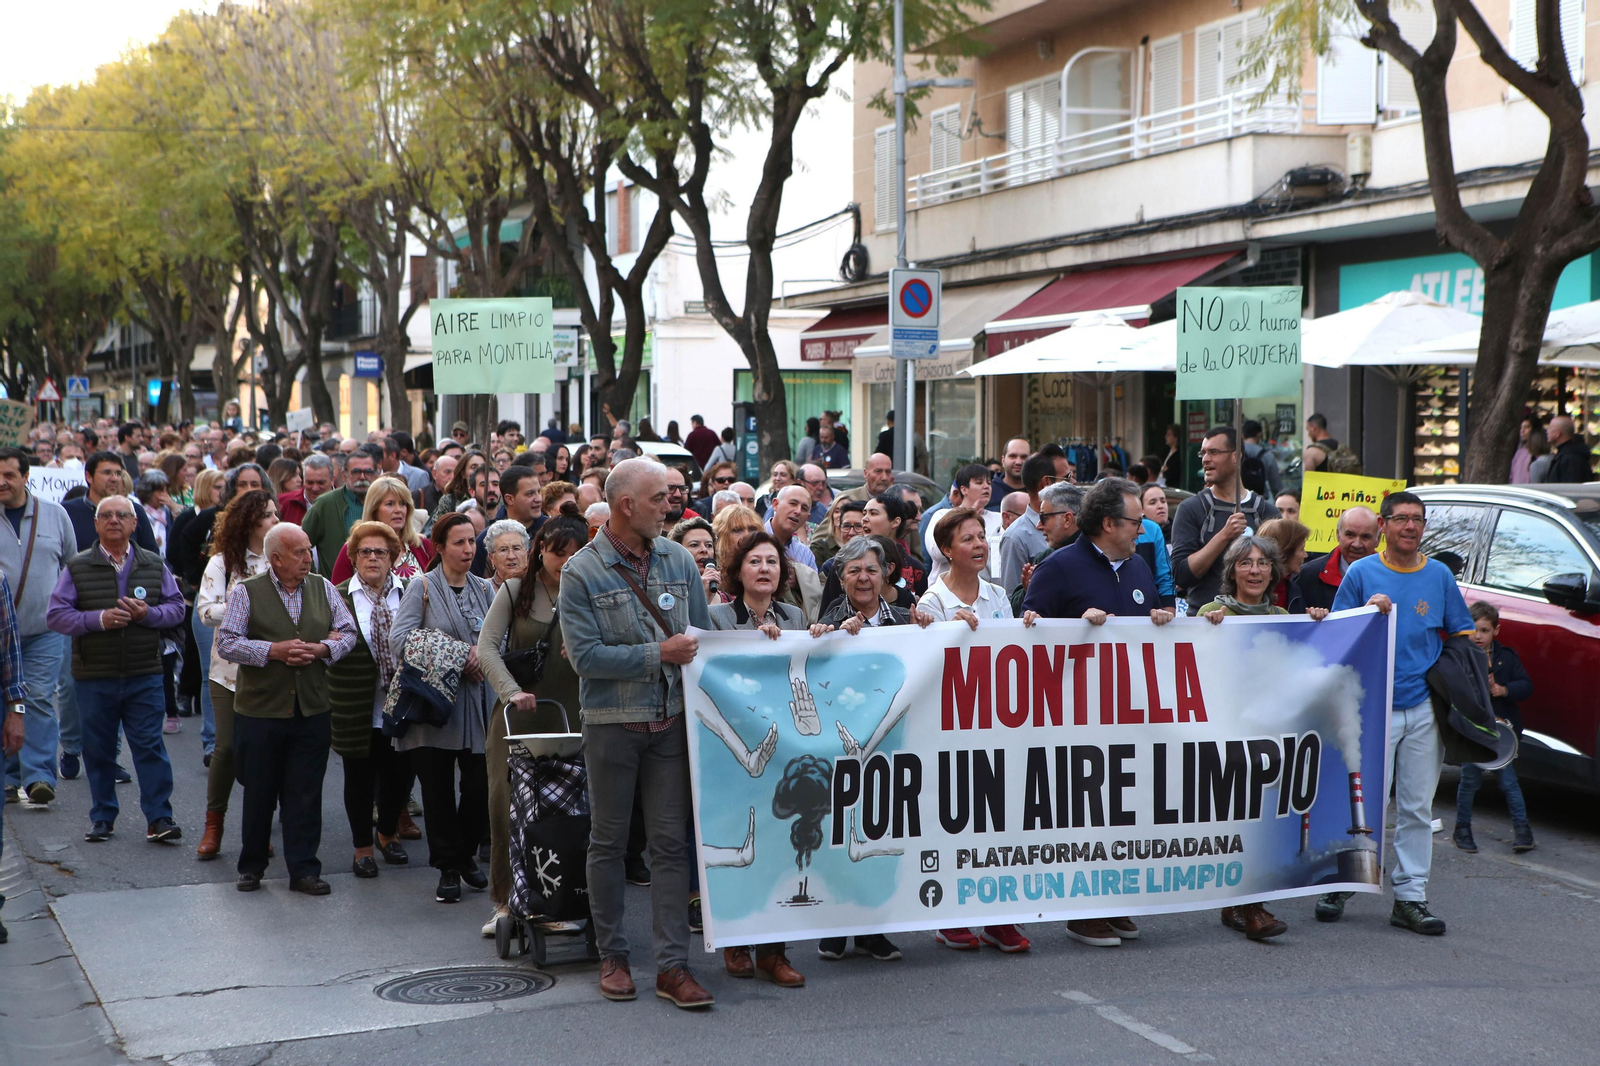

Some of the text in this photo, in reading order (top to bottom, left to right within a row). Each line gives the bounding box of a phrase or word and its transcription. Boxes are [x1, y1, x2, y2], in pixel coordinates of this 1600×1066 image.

[434, 311, 544, 336] AIRE LIMPIO
[1183, 296, 1298, 333] NO al humo
[435, 341, 553, 366] PARA MONTILLA
[1179, 351, 1197, 374] de
[1316, 486, 1377, 504] Los niños
[941, 642, 1207, 731] MONTILLA
[831, 731, 1322, 847] POR UN AIRE LIMPIO
[957, 834, 1244, 869] PLATAFORMA CIUDADANA
[957, 861, 1243, 905] POR UN AIRE LIMPIO
